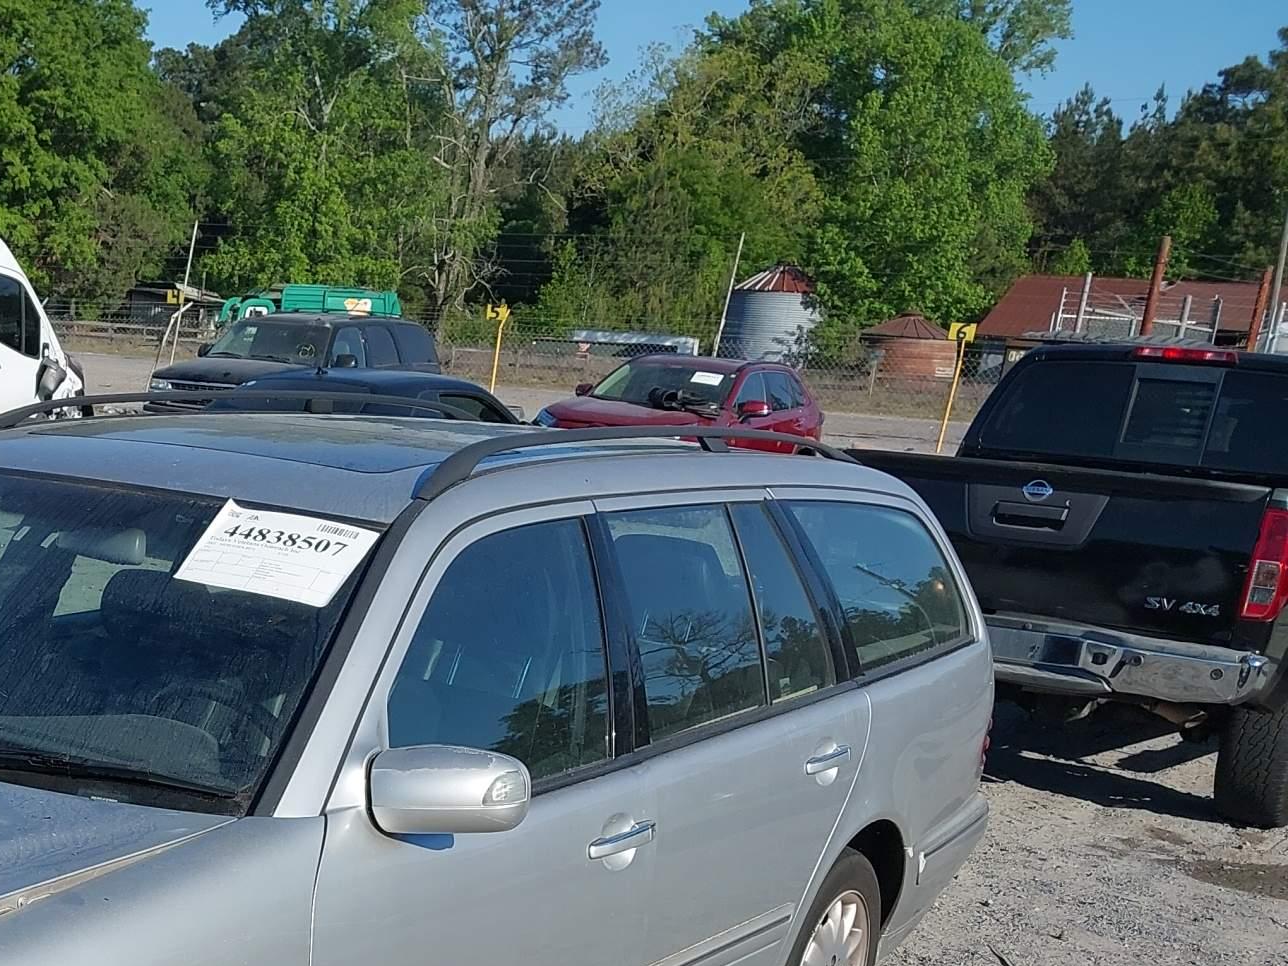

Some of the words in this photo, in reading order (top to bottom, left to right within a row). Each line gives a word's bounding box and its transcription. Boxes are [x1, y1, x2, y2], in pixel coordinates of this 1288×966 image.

[490, 307, 500, 319] 5
[956, 323, 970, 340] 6
[224, 524, 349, 557] 44838507
[1144, 596, 1176, 611] SV
